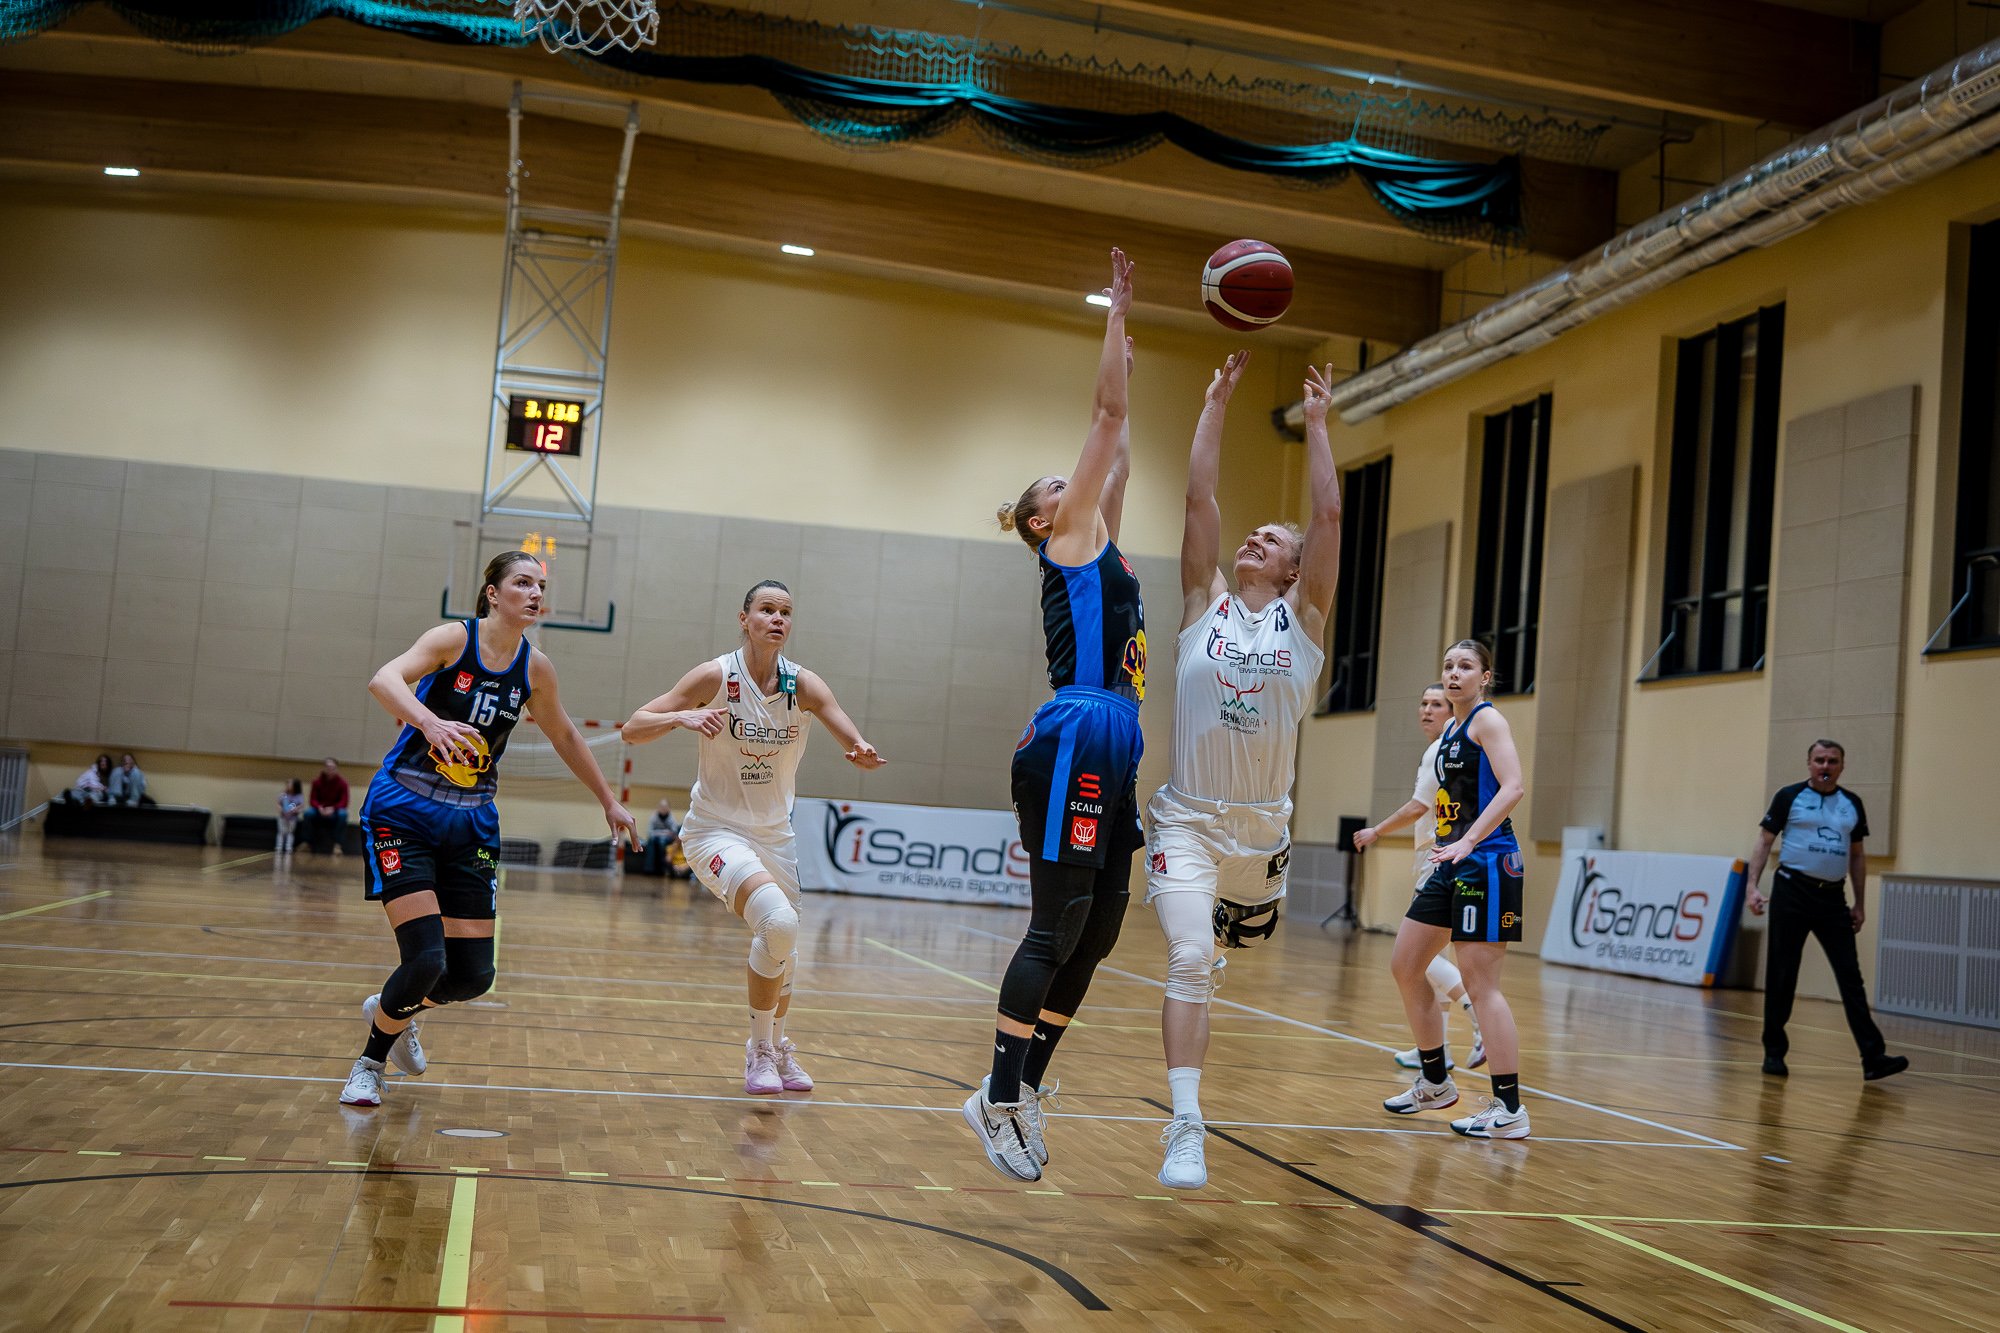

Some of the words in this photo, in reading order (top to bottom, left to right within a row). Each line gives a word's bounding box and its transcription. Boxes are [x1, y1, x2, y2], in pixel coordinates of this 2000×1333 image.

[535, 424, 564, 451] 12
[1274, 602, 1290, 632] 13
[1216, 641, 1292, 668] iSandS
[786, 680, 796, 690] C
[468, 691, 499, 727] 15
[739, 722, 799, 739] iSandS
[1070, 801, 1103, 814] SCALIO
[375, 838, 402, 850] SCALIO
[850, 827, 1031, 880] iSandS
[878, 870, 964, 889] enklawa
[968, 878, 1031, 897] sport
[1462, 904, 1477, 933] 0
[1583, 888, 1709, 942] iSandS
